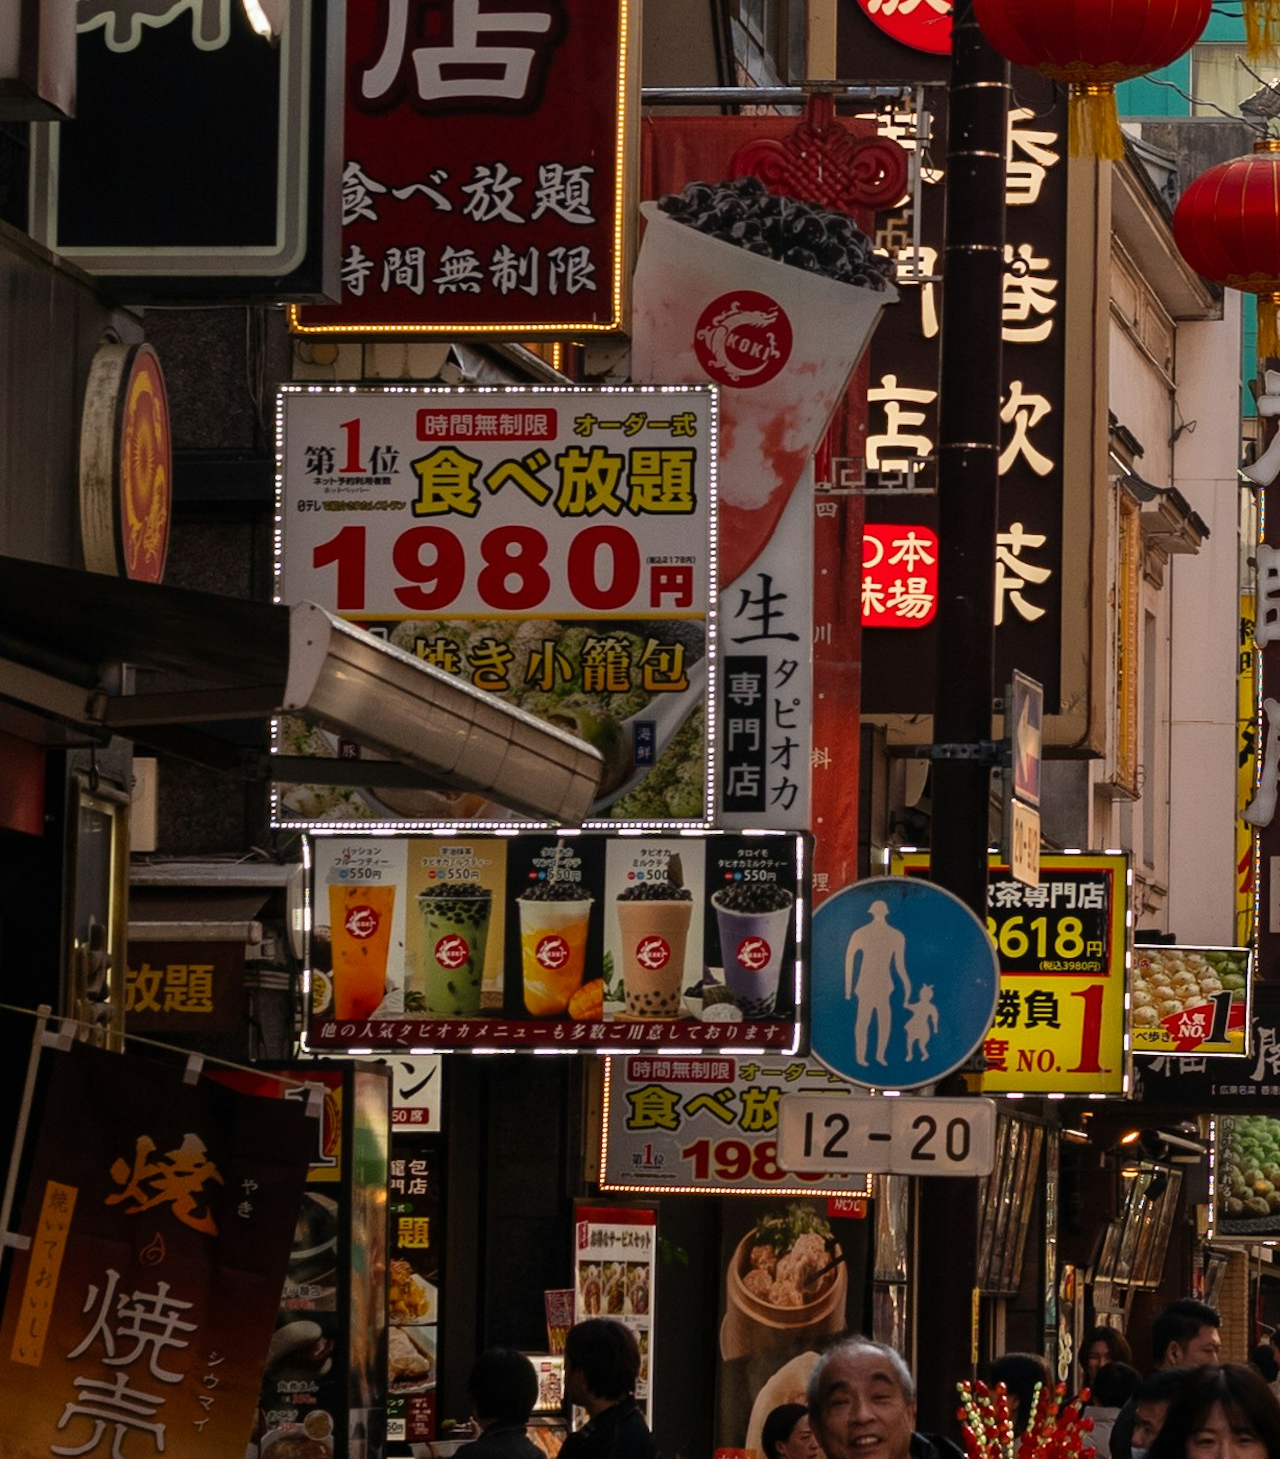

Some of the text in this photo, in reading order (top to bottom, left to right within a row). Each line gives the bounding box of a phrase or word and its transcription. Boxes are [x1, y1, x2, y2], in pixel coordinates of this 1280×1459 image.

[726, 333, 771, 361] KOKI
[424, 414, 549, 436] 時間無制限
[574, 413, 697, 437] オーダー式
[304, 418, 401, 476] 第1位
[411, 446, 697, 517] 食べ放題
[732, 573, 799, 645] 生
[726, 672, 762, 798] 専門店
[770, 659, 801, 811] タピオカ
[349, 868, 382, 880] 550円
[447, 868, 480, 880] 550円
[743, 869, 777, 882] 550円
[1016, 1049, 1062, 1073] NO.
[1066, 984, 1113, 1074] 1
[1177, 1012, 1206, 1025] 人気
[1178, 1025, 1207, 1039] NO.
[631, 1061, 731, 1081] 時間無制限
[626, 1084, 850, 1132] 食べ放
